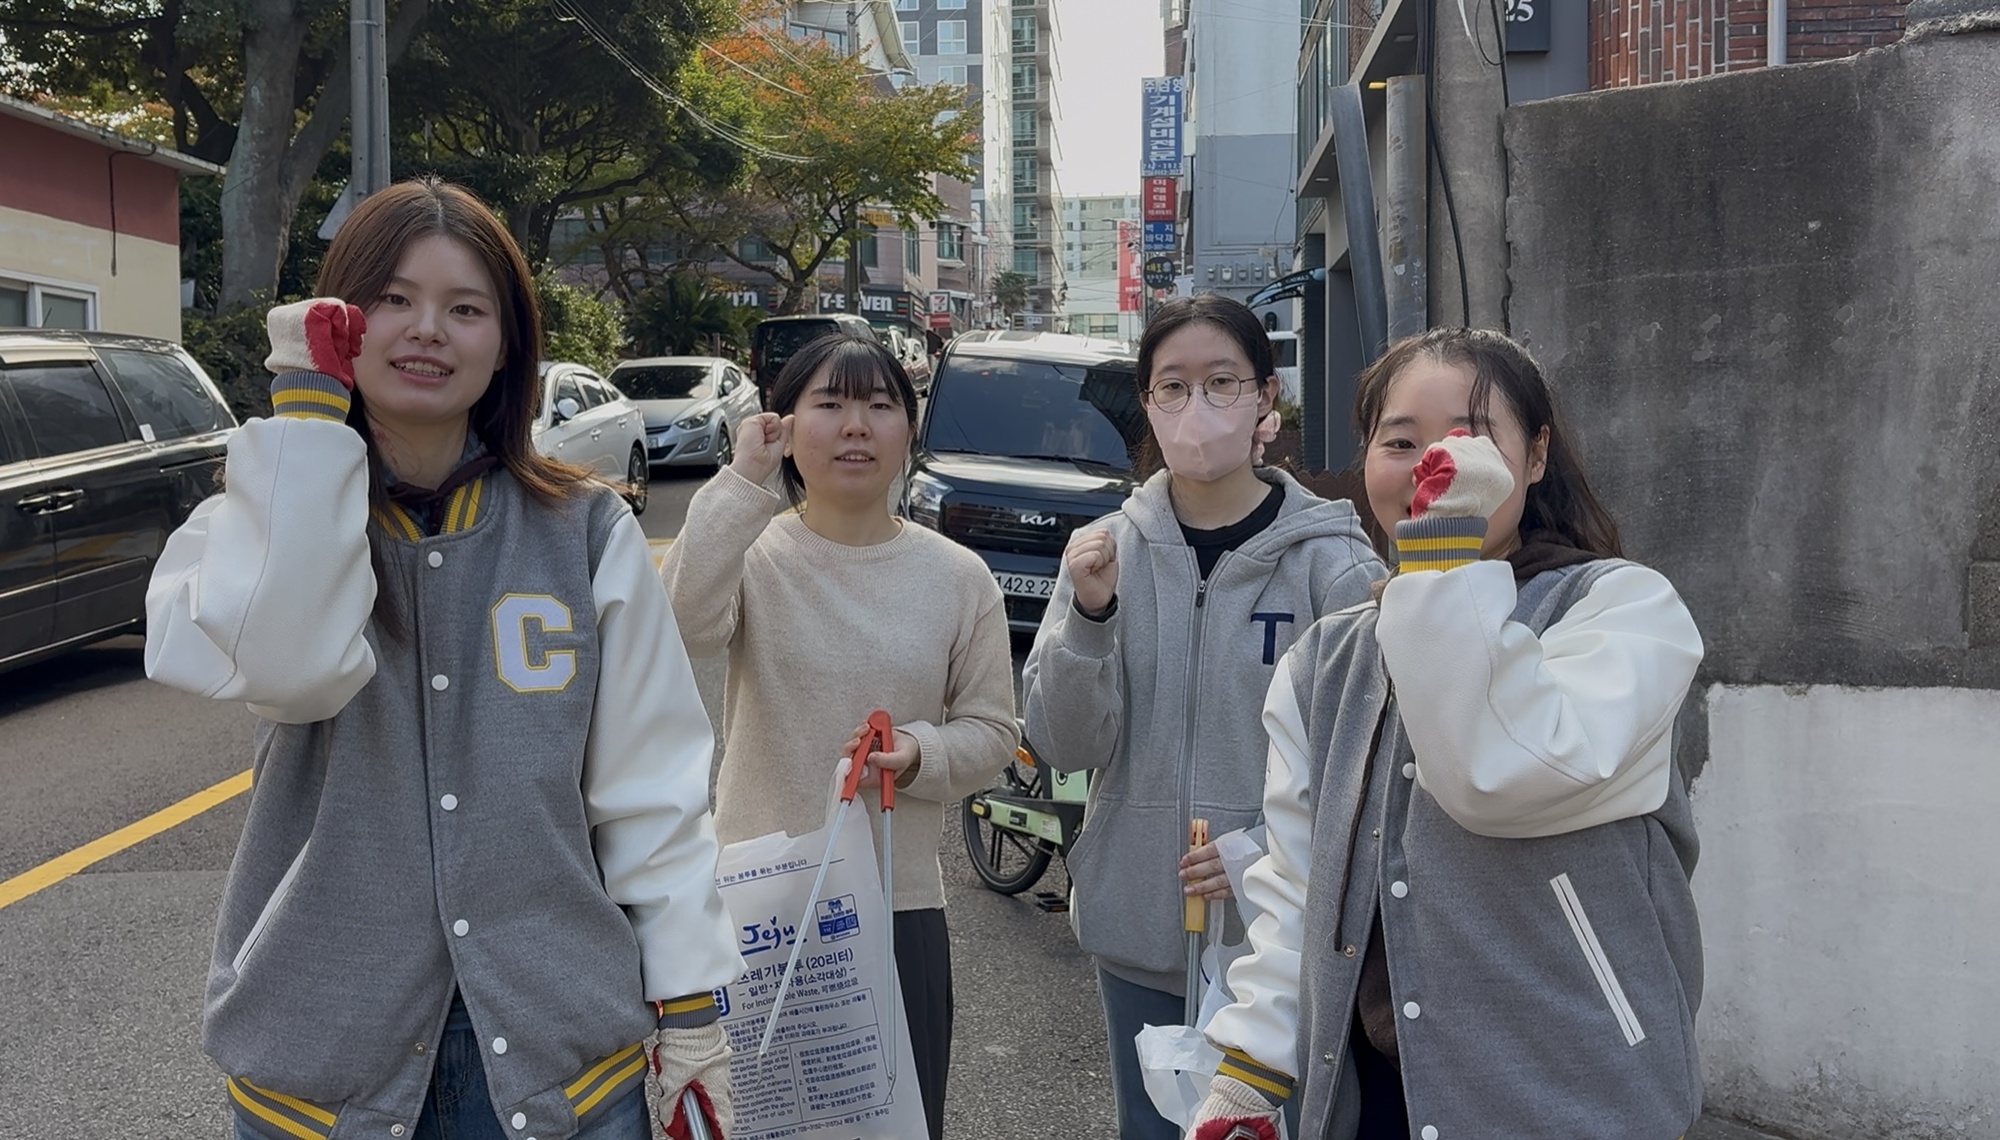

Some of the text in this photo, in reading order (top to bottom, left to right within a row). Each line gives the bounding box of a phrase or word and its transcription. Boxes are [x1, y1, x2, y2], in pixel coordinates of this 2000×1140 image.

[490, 592, 577, 693] C
[1250, 612, 1295, 666] T
[741, 915, 796, 949] Jeju
[806, 947, 854, 971] (20리터)
[742, 1001, 755, 1011] For
[796, 986, 820, 999] Waste,
